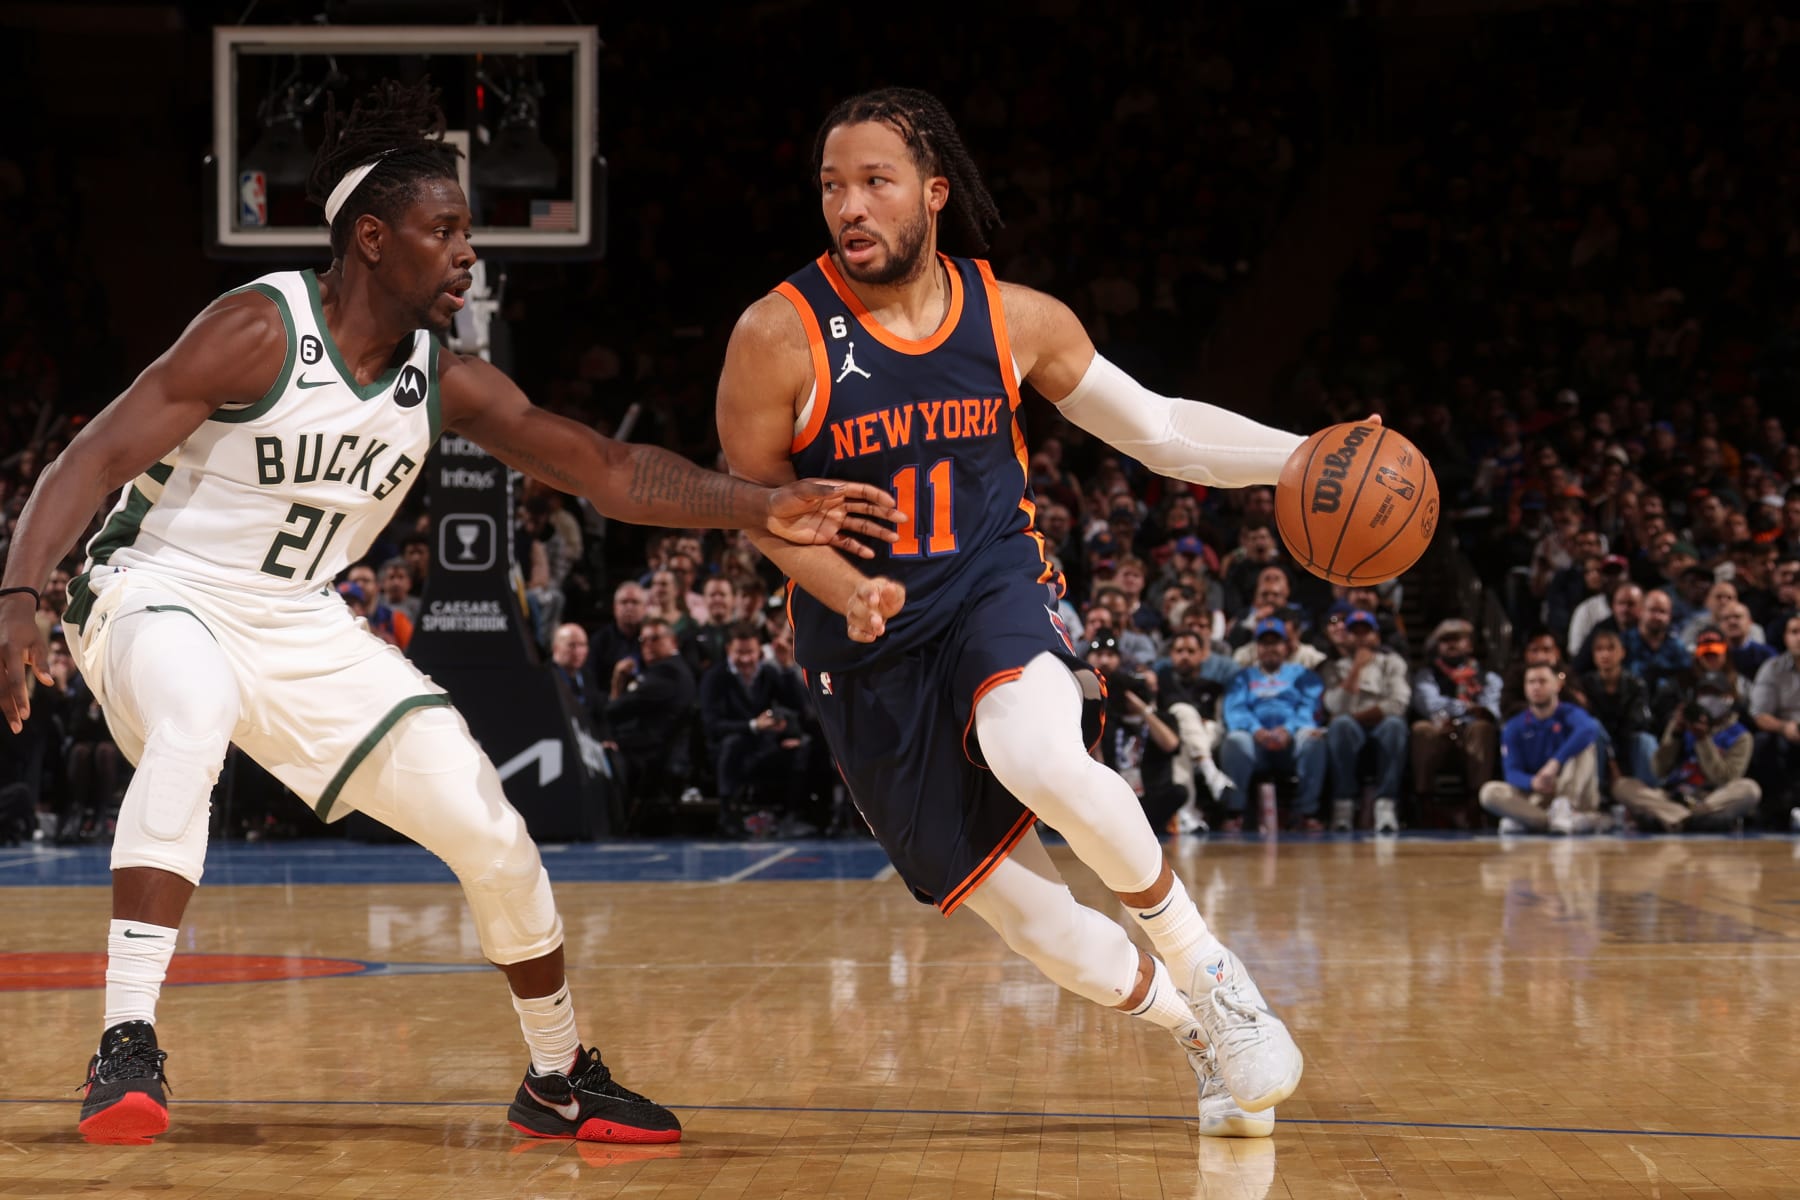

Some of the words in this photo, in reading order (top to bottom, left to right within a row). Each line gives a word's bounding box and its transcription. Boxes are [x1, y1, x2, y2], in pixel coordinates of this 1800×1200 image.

[829, 316, 848, 339] 6
[302, 338, 317, 361] 6
[830, 404, 914, 460] NEW
[918, 398, 1002, 441] YORK
[255, 433, 417, 501] BUCKS
[441, 468, 495, 490] Infosys
[1312, 426, 1374, 514] Wilson
[889, 457, 960, 558] 11
[260, 502, 347, 581] 21
[422, 614, 508, 632] SPORTSBOOK
[430, 601, 501, 616] CAESARS
